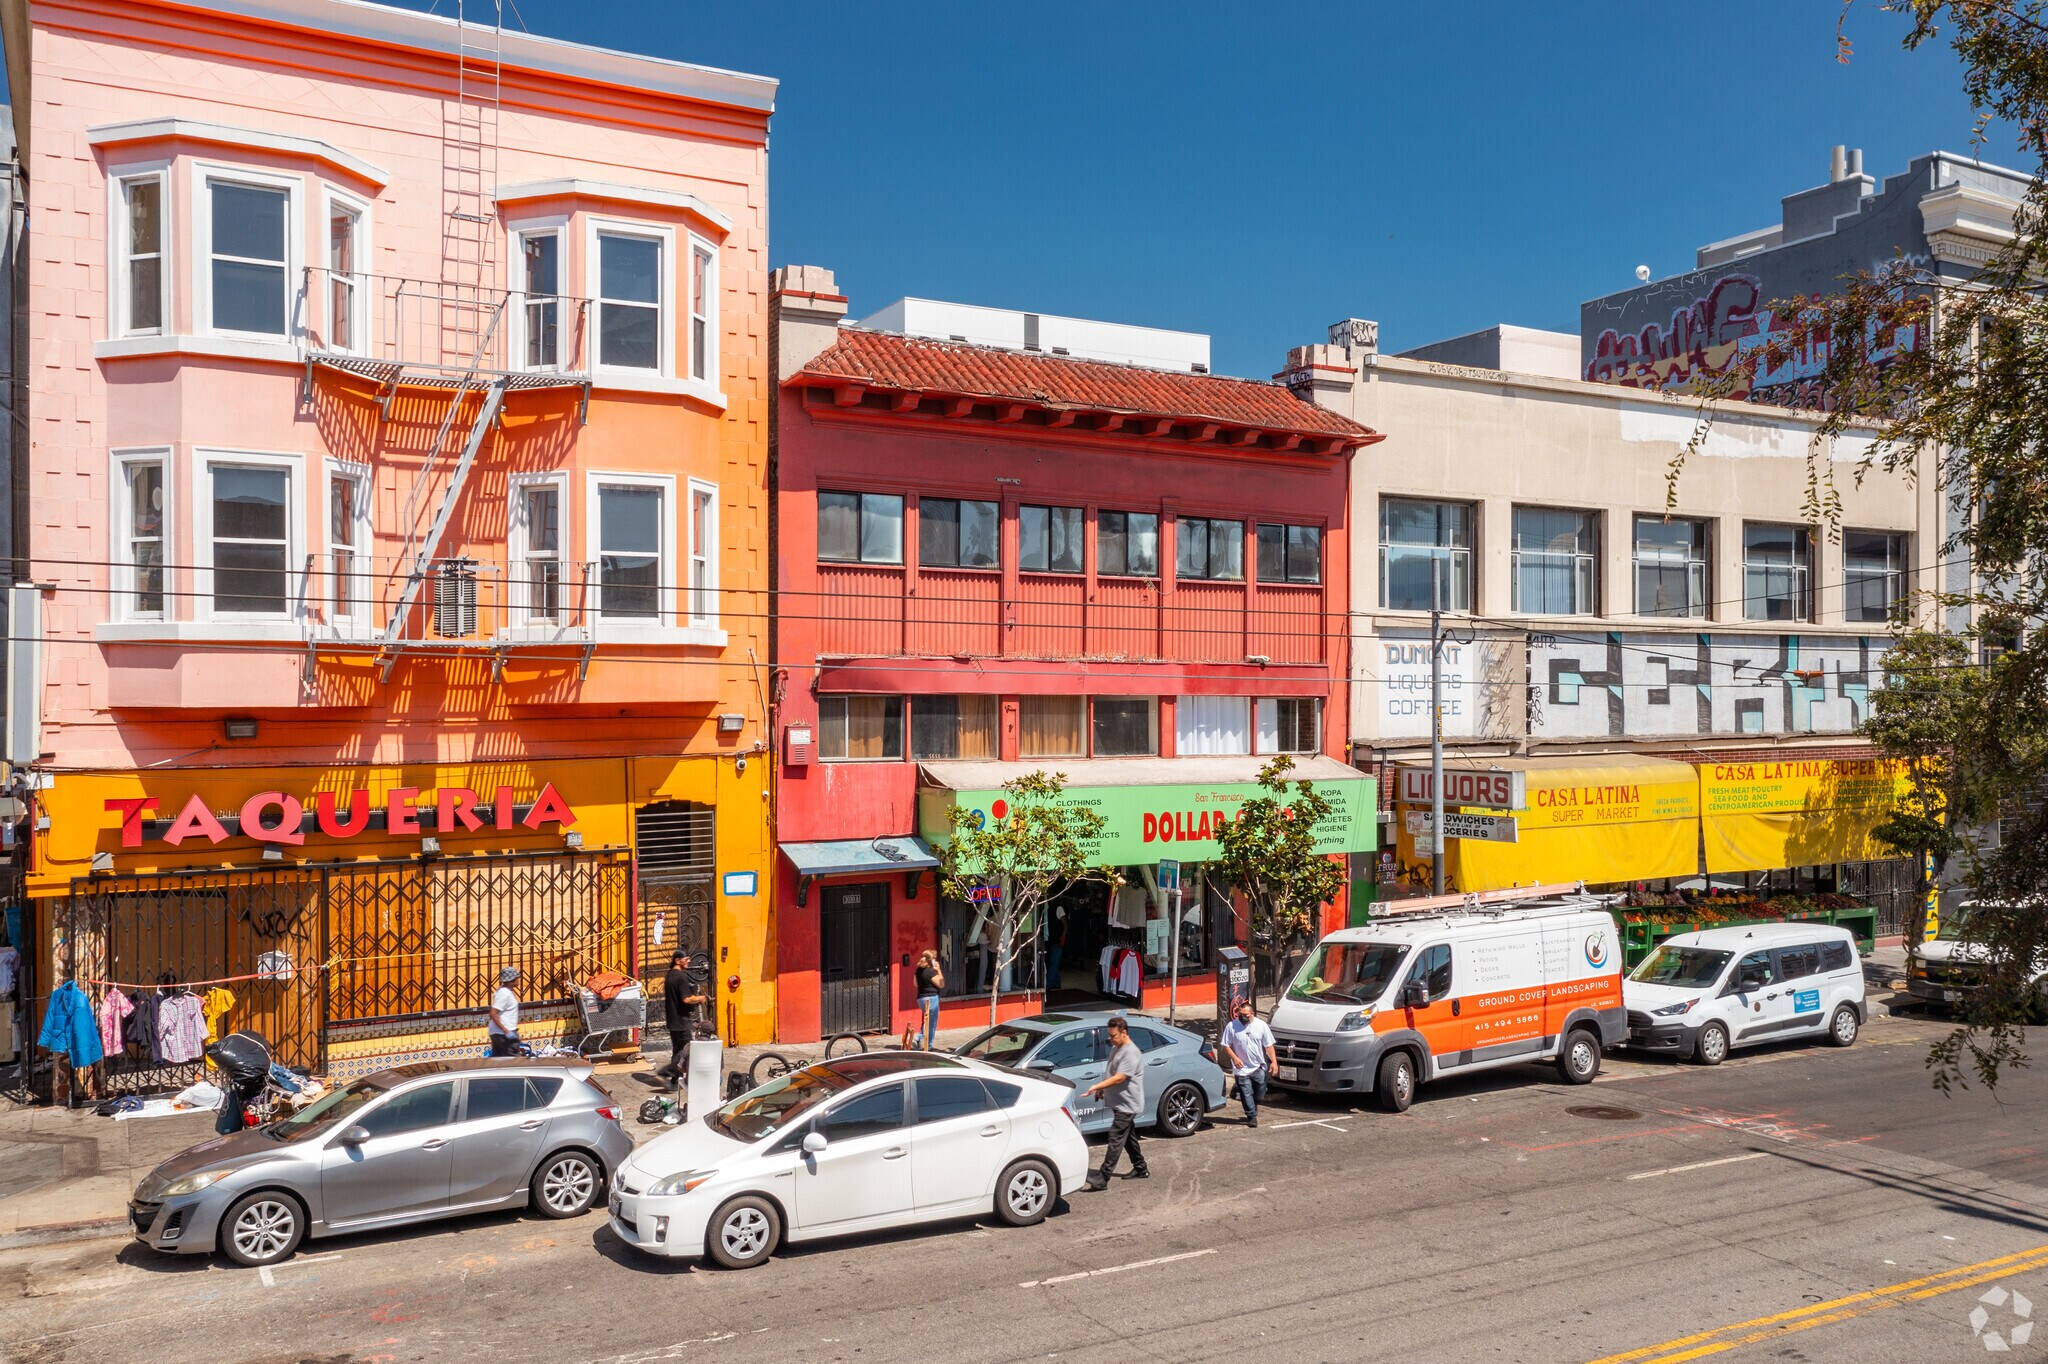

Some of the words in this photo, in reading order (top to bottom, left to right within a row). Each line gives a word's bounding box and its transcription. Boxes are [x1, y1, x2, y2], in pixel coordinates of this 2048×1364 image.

[1389, 699, 1462, 715] COFFEE
[1715, 765, 1755, 781] CASA
[1763, 762, 1821, 779] LATINA
[1831, 760, 1876, 776] SUPER
[1537, 787, 1578, 807] CASA
[1584, 785, 1640, 805] LATINA
[1708, 787, 1730, 795] FRESH
[1731, 786, 1750, 794] MEAT
[1751, 784, 1783, 793] POULTRY
[1056, 799, 1102, 807] CLOTHINGS
[1195, 792, 1209, 803] San
[1211, 792, 1244, 802] Francisco
[1713, 795, 1726, 803] SEA
[1728, 794, 1749, 802] FOOD
[1752, 793, 1768, 801] AND
[1708, 801, 1774, 811] CENTROAMERICAN
[104, 781, 577, 848] TAQUERIA
[1315, 815, 1352, 824] UGUETES
[1423, 813, 1495, 826] SDWICHES
[1552, 810, 1584, 823] SUPER
[1596, 806, 1640, 820] MARKET
[1143, 810, 1225, 843] DOLLAR
[1316, 824, 1348, 833] HIGIENE
[971, 887, 1001, 900] OPEN
[1478, 994, 1516, 1007] GROUND
[1519, 990, 1547, 1001] COVER
[1551, 980, 1609, 996] LANDSCAPING
